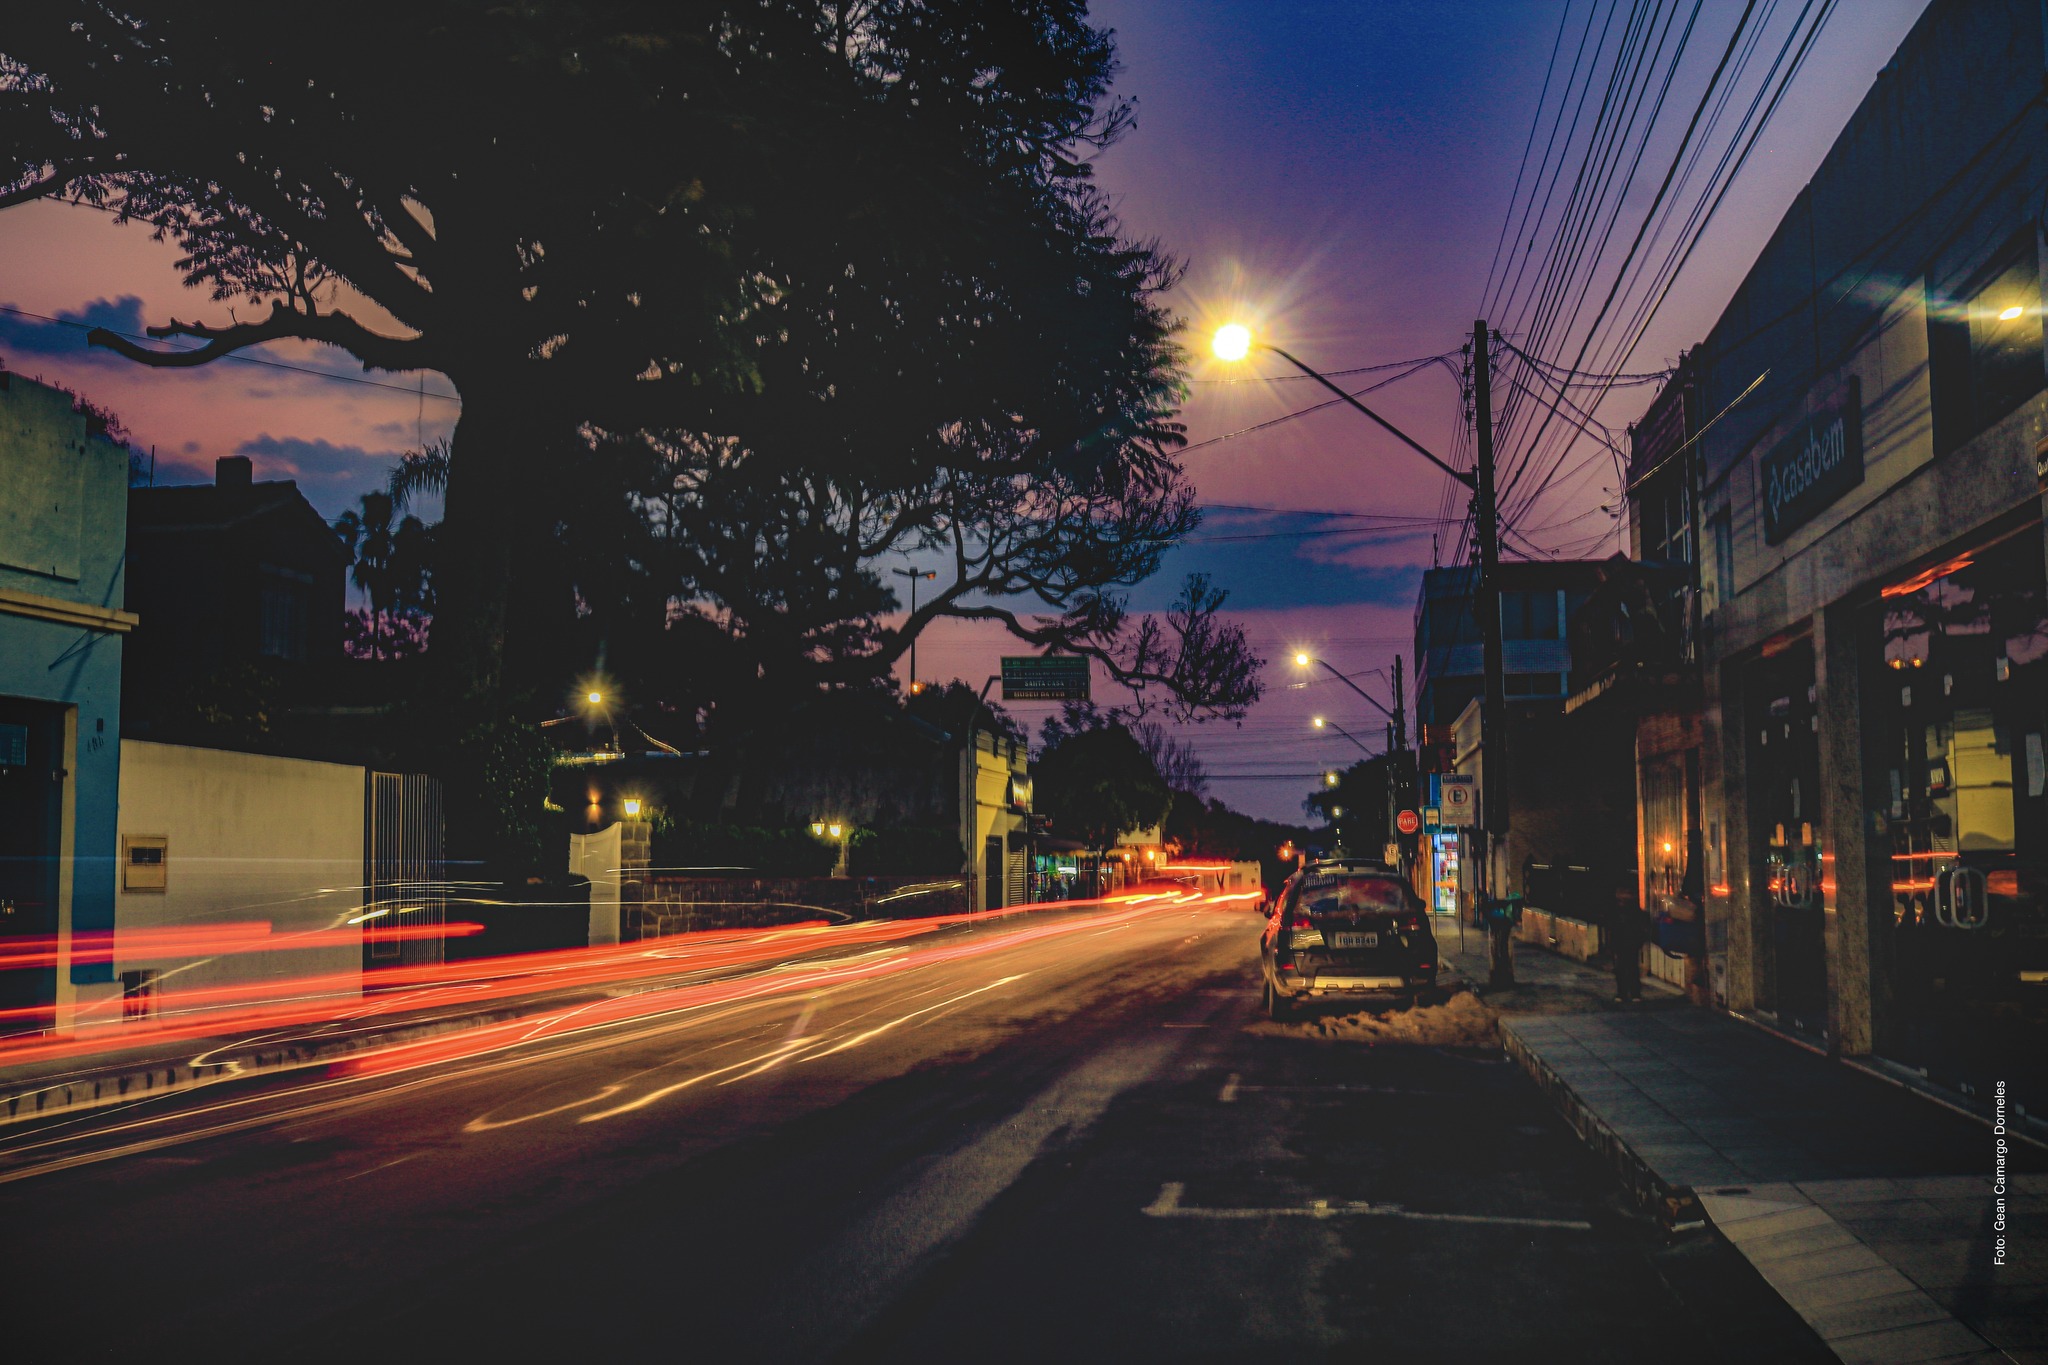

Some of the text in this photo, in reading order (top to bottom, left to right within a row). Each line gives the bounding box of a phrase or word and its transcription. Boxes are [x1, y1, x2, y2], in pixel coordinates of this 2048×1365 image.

[1782, 417, 1845, 504] casabem
[1453, 789, 1462, 802] E
[1399, 816, 1416, 827] PARE
